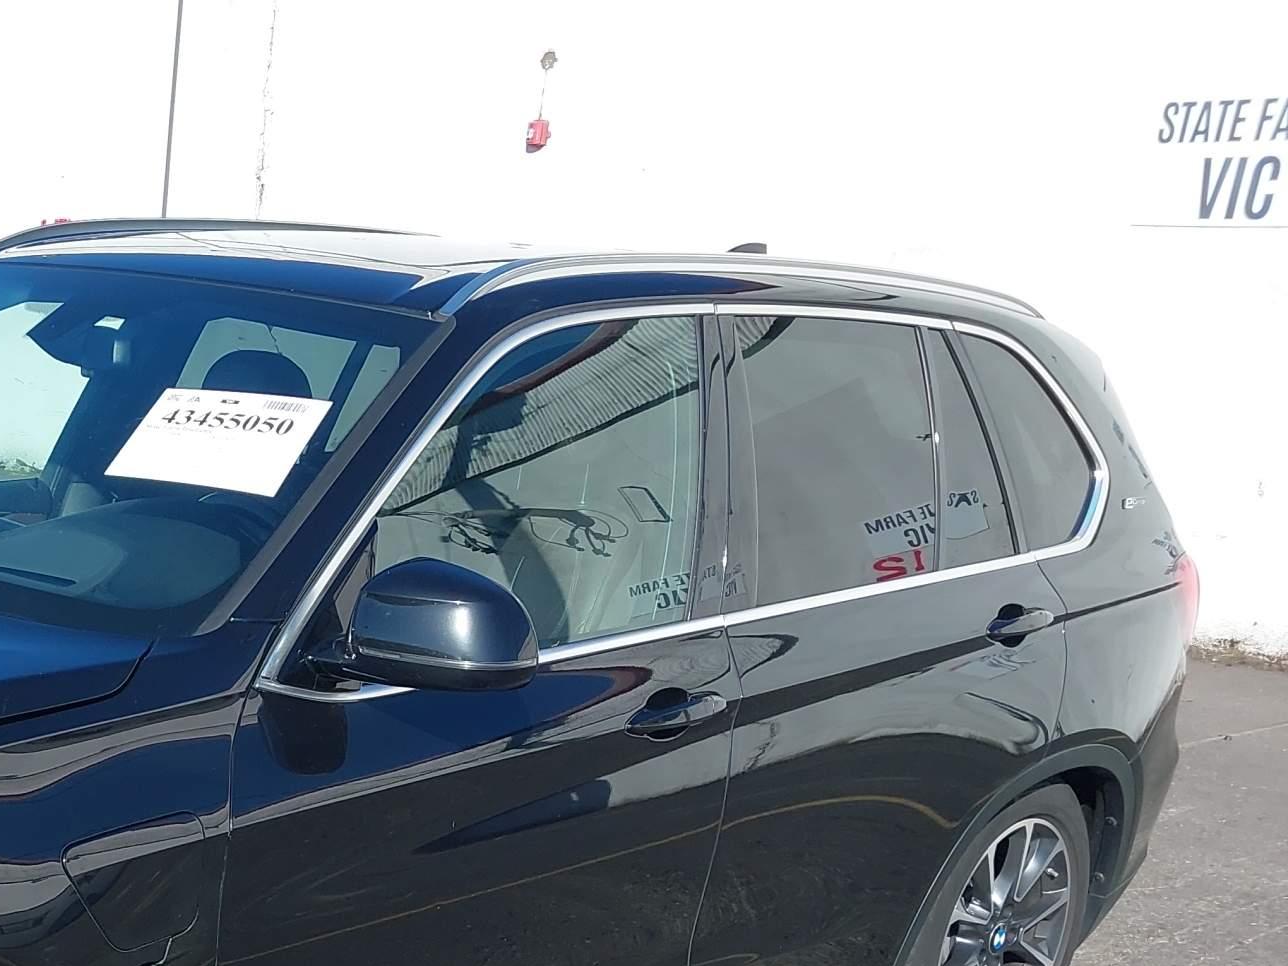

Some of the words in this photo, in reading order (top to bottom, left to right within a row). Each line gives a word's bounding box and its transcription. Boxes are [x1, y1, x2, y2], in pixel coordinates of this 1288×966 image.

[1158, 99, 1251, 143] STATE
[1198, 156, 1281, 220] VIC
[161, 408, 295, 436] 43455050
